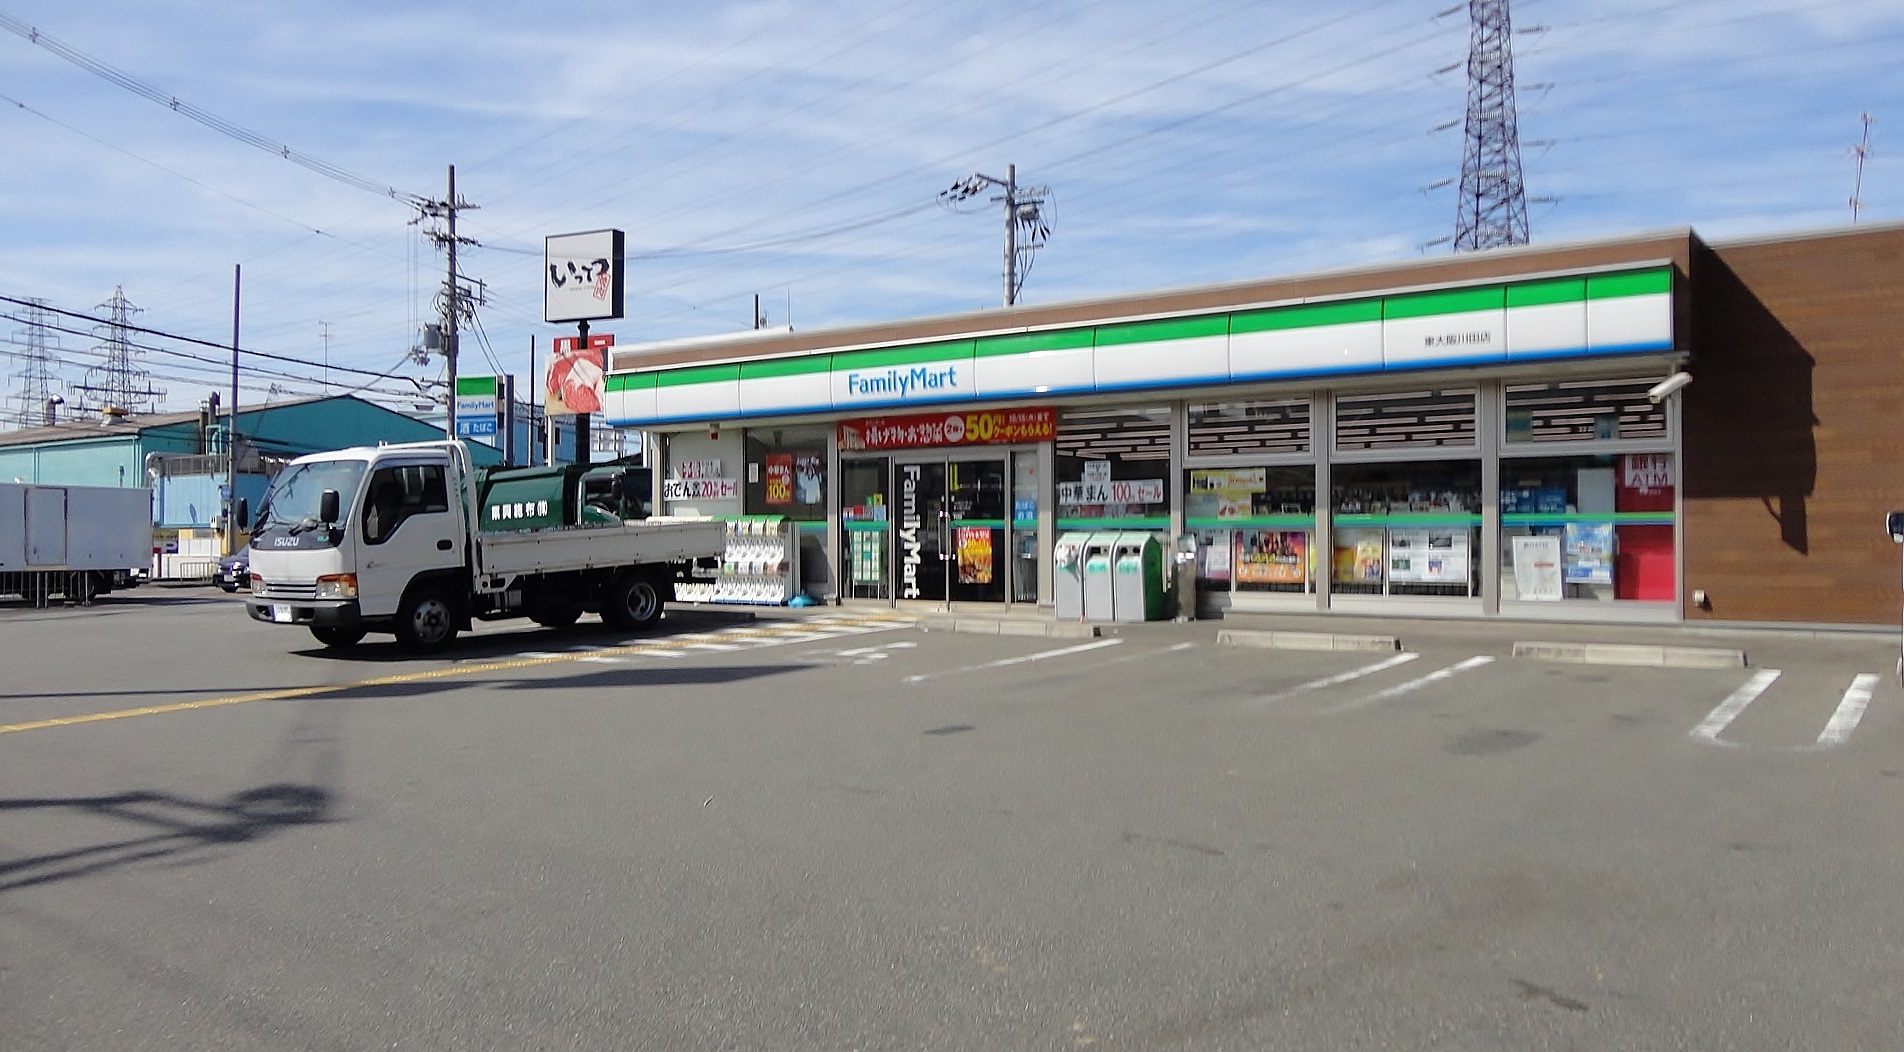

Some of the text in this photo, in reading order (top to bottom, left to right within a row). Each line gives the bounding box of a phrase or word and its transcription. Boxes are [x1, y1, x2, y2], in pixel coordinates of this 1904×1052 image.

[848, 366, 956, 397] FamilyMart
[457, 401, 494, 411] FamilyMart
[274, 537, 299, 546] ISUZU
[900, 465, 921, 599] FamilyMart
